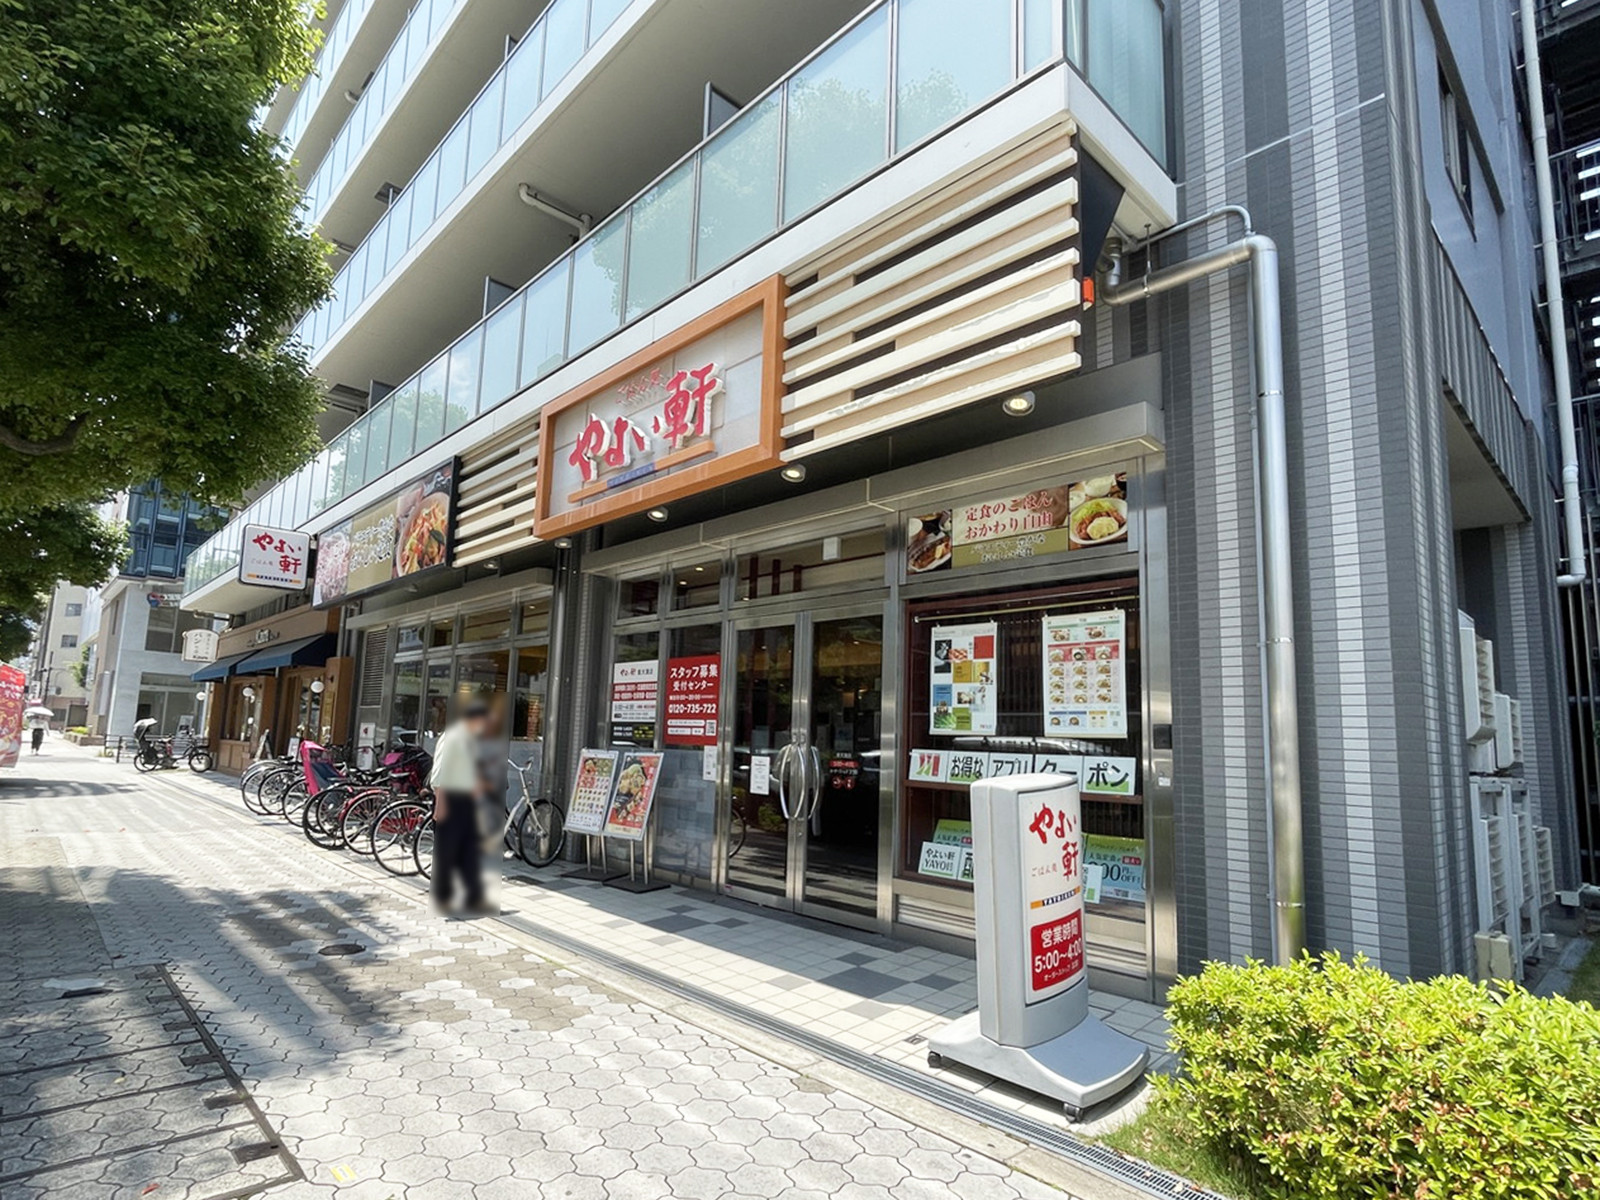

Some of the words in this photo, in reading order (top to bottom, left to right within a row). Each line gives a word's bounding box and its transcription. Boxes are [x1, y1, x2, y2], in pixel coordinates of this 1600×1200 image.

[569, 362, 724, 482] やよい軒
[965, 491, 1054, 522] 定食のごはん
[965, 511, 1053, 540] おかわり自由
[252, 532, 302, 553] やよい
[279, 555, 302, 575] 軒
[670, 663, 718, 679] スタッフ募集
[673, 680, 714, 691] 受付センター
[668, 703, 717, 714] 0120-735-722
[1029, 803, 1077, 844] やよい
[1062, 841, 1079, 881] 軒
[1088, 861, 1121, 881] 00
[1041, 919, 1078, 949] 営業時間
